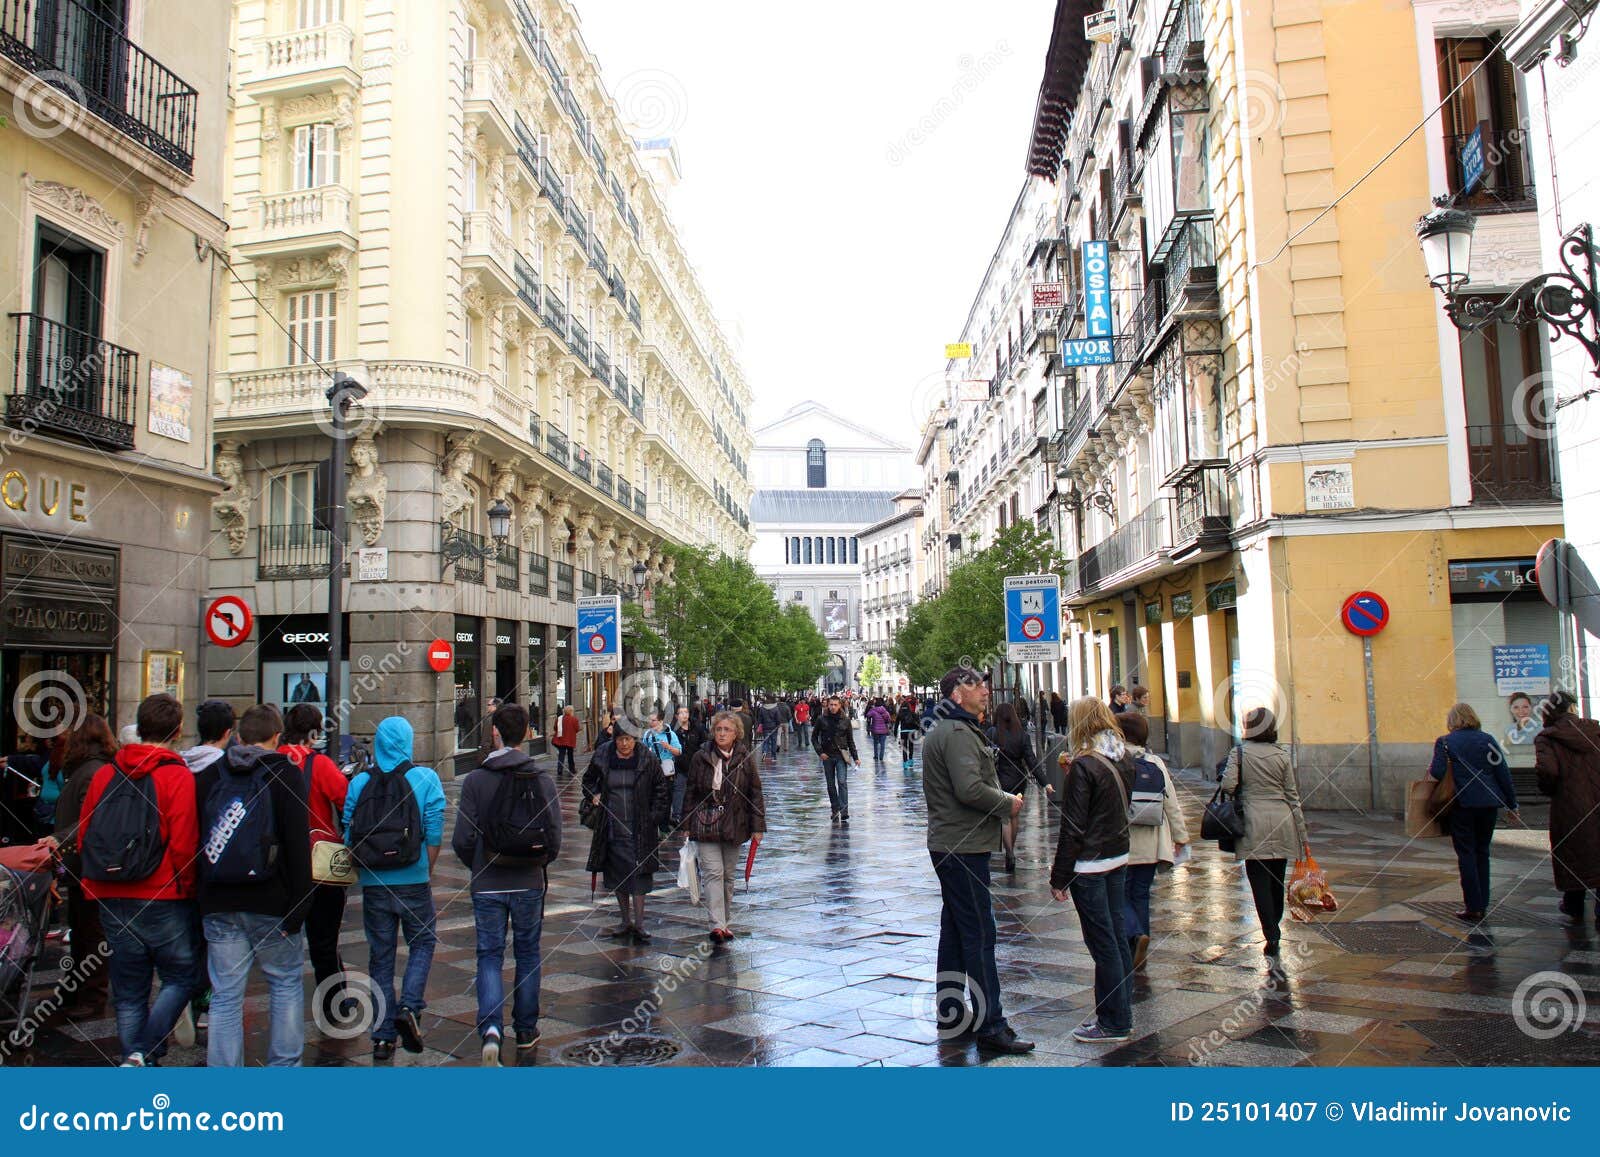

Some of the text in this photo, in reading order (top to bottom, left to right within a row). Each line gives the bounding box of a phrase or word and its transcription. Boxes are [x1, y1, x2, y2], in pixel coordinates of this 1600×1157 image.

[1086, 243, 1108, 336] HOSTAL
[1065, 340, 1111, 356] IVOR
[1094, 355, 1111, 364] Piso
[1, 470, 87, 523] QUE
[14, 606, 109, 632] PALOMEQUE
[282, 633, 330, 643] GEOX
[456, 632, 474, 642] GEOX
[496, 635, 511, 645] GEOX
[528, 637, 540, 646] GEOX
[1495, 667, 1518, 677] 219
